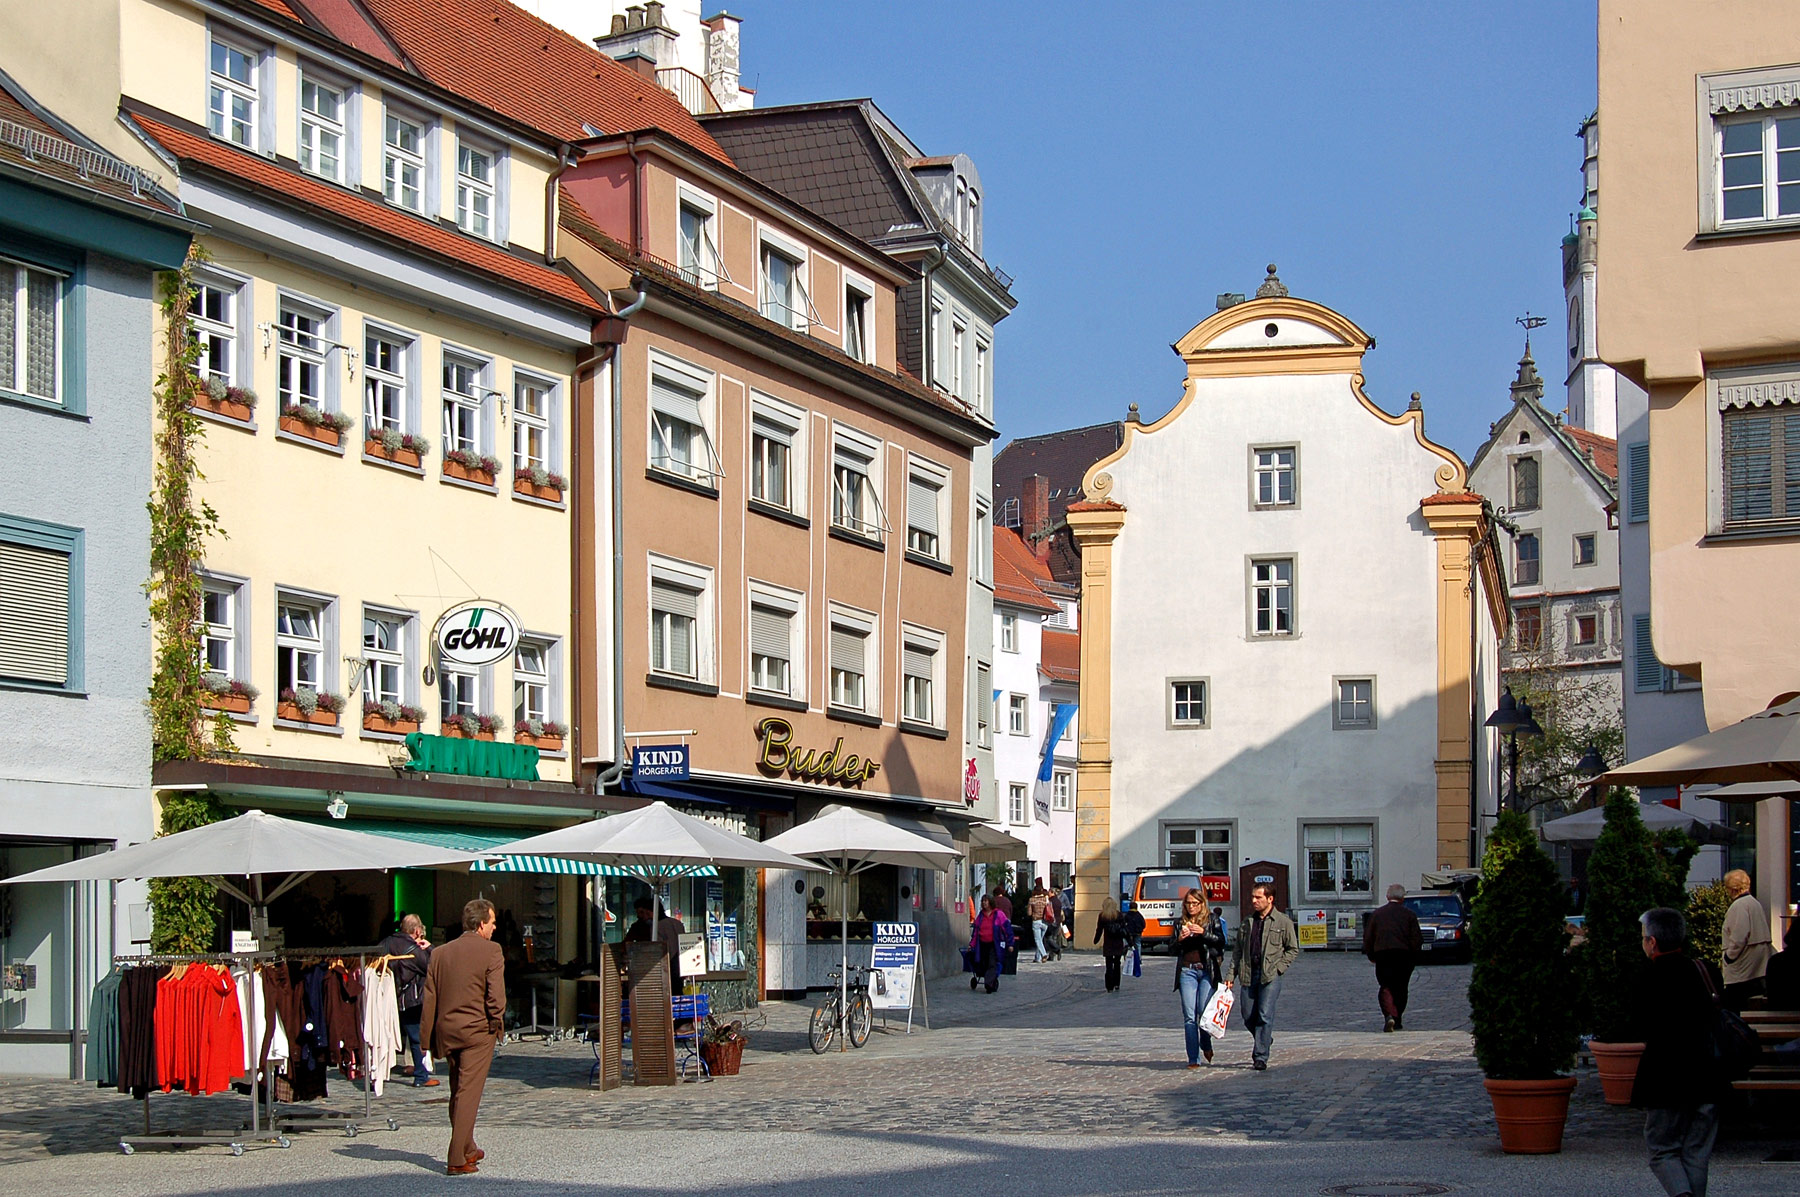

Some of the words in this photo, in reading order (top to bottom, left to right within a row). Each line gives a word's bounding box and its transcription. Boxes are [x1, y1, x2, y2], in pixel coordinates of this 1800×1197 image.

[444, 609, 506, 650] GÖHL
[638, 750, 684, 766] KIND
[758, 717, 881, 785] Buder
[638, 766, 684, 776] HÖRGERÄTE
[877, 924, 916, 936] KIND
